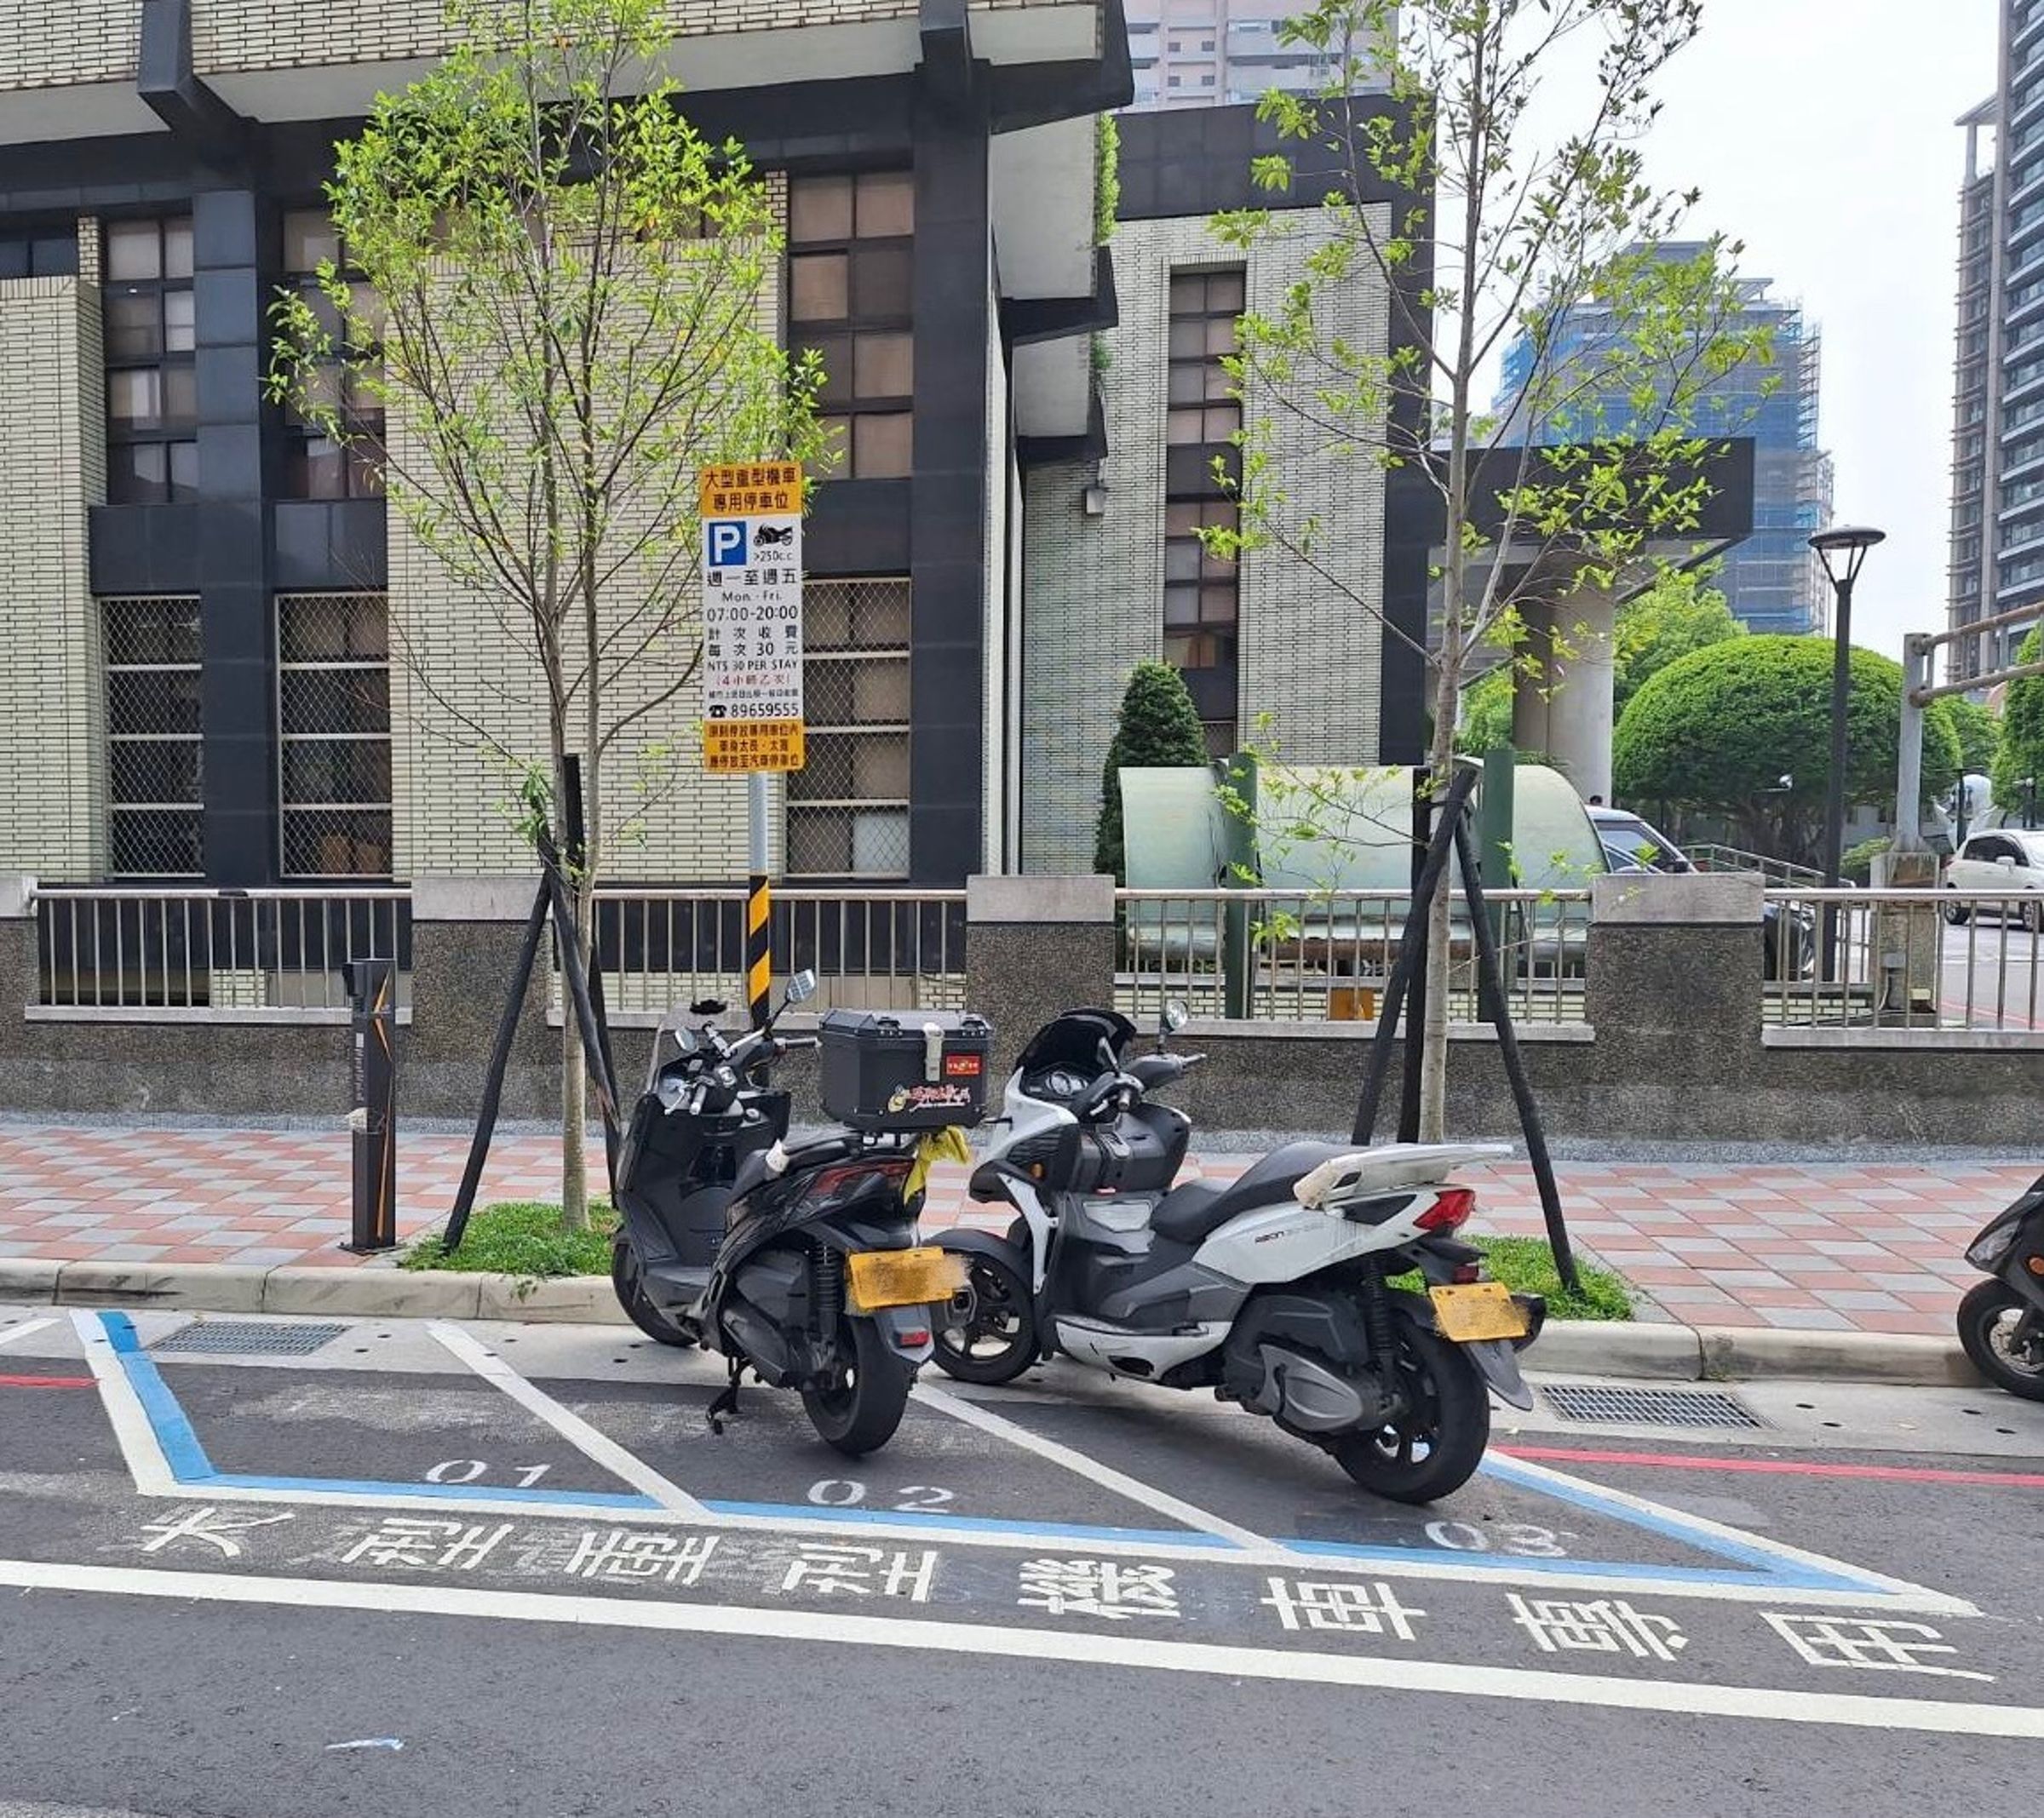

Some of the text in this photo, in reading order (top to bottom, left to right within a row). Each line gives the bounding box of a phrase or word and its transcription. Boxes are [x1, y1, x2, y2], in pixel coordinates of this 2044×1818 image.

[705, 467, 795, 490] 大型重型機車
[713, 490, 789, 512] 專用停車位
[714, 525, 741, 564] P
[707, 568, 797, 587] 週一至週五
[707, 605, 799, 622] 07:00-20:00
[748, 659, 766, 671] PER
[772, 659, 797, 670] STAY
[732, 703, 799, 718] 89659555
[426, 1460, 551, 1487] 01
[807, 1480, 955, 1513] 02
[1425, 1521, 1567, 1557] 03
